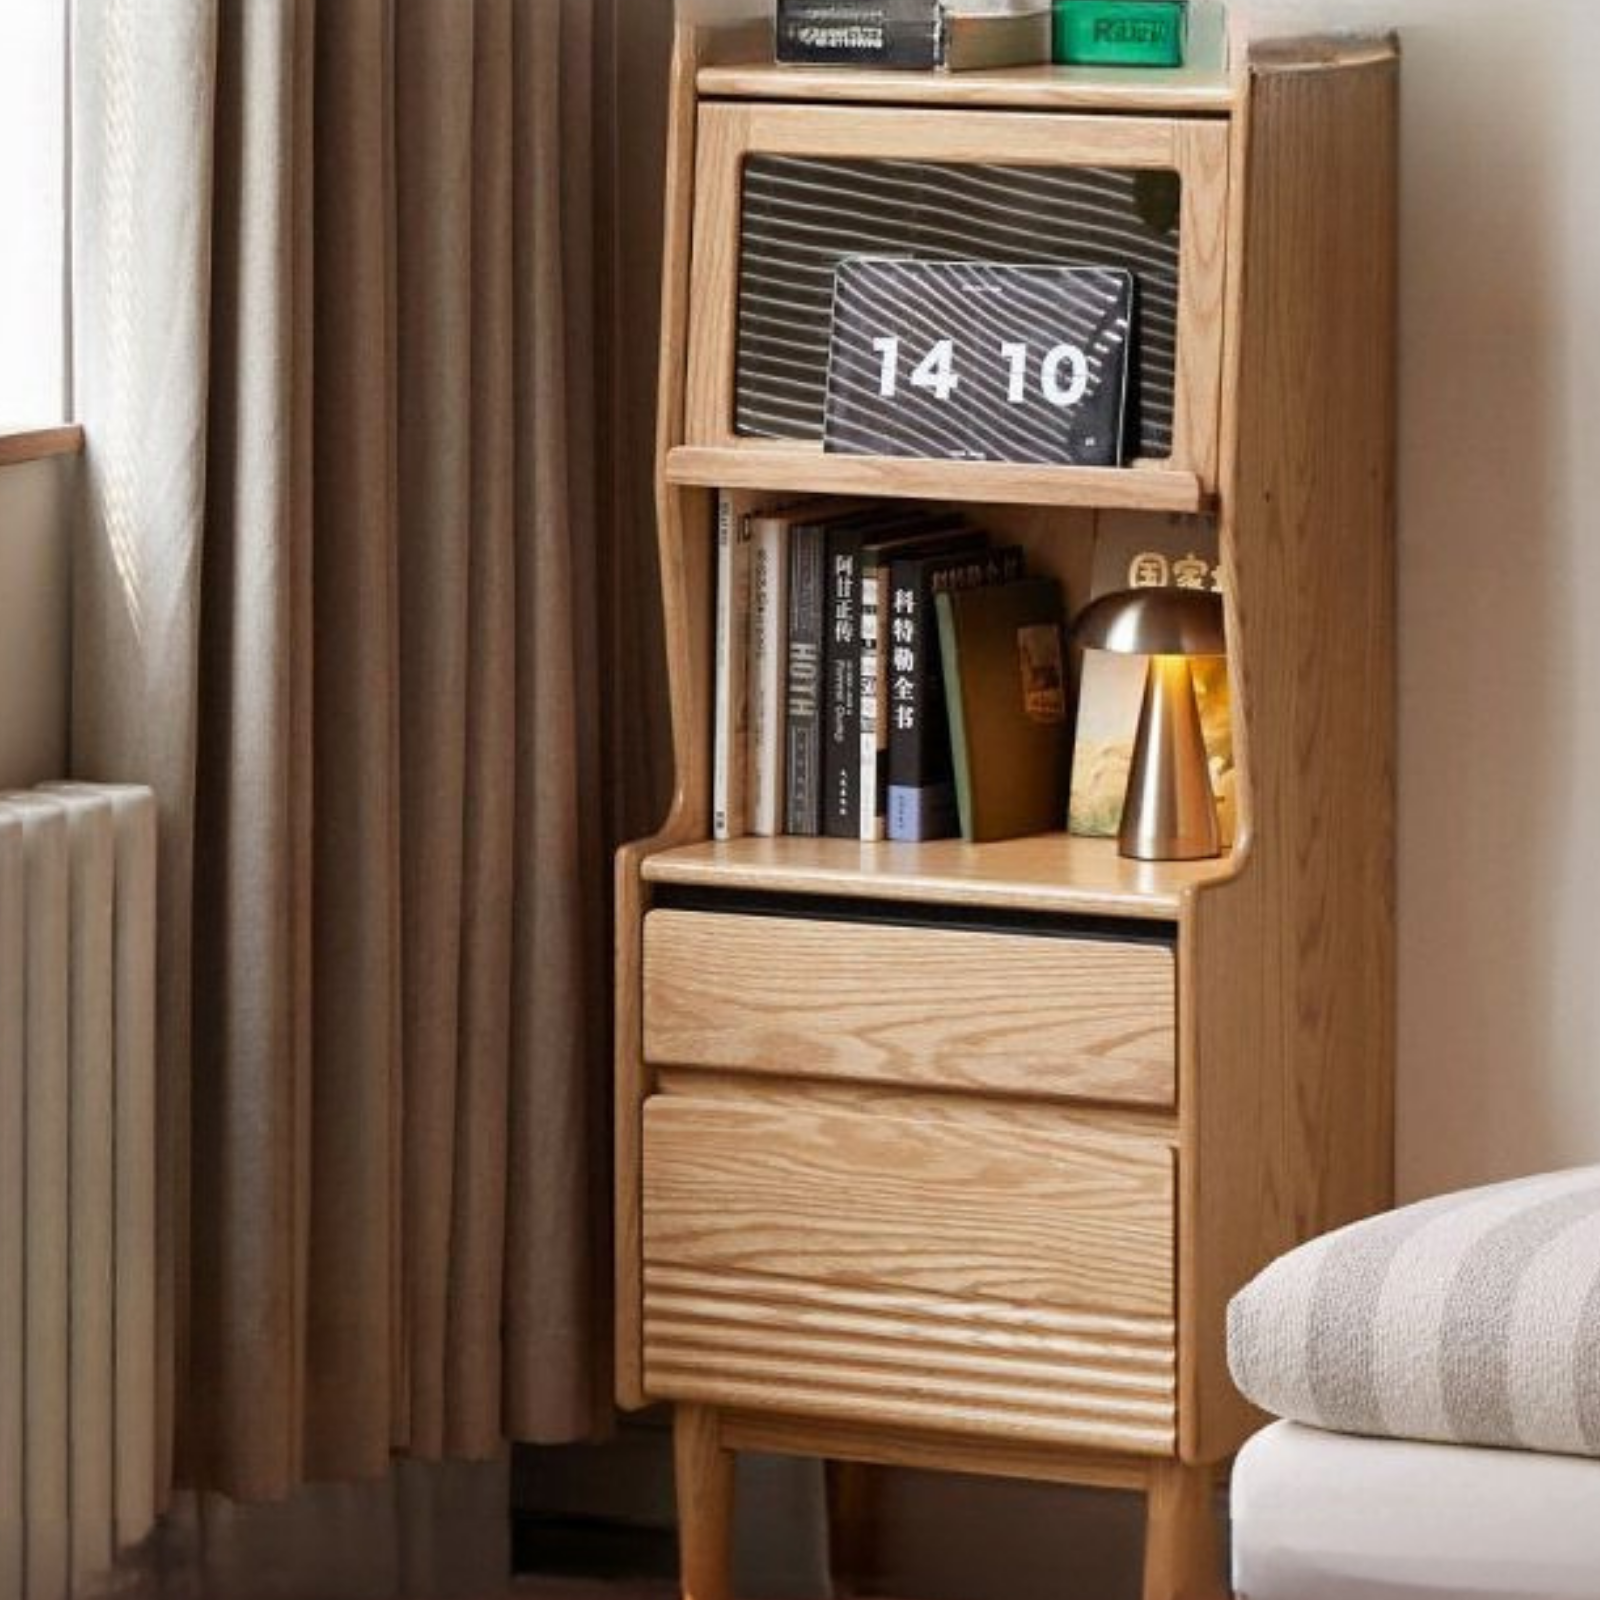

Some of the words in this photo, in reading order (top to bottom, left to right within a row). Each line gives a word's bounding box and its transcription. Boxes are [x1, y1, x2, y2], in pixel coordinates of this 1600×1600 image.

[873, 337, 959, 400] 14
[1001, 342, 1089, 406] 10
[893, 589, 915, 730] 科特勒全书
